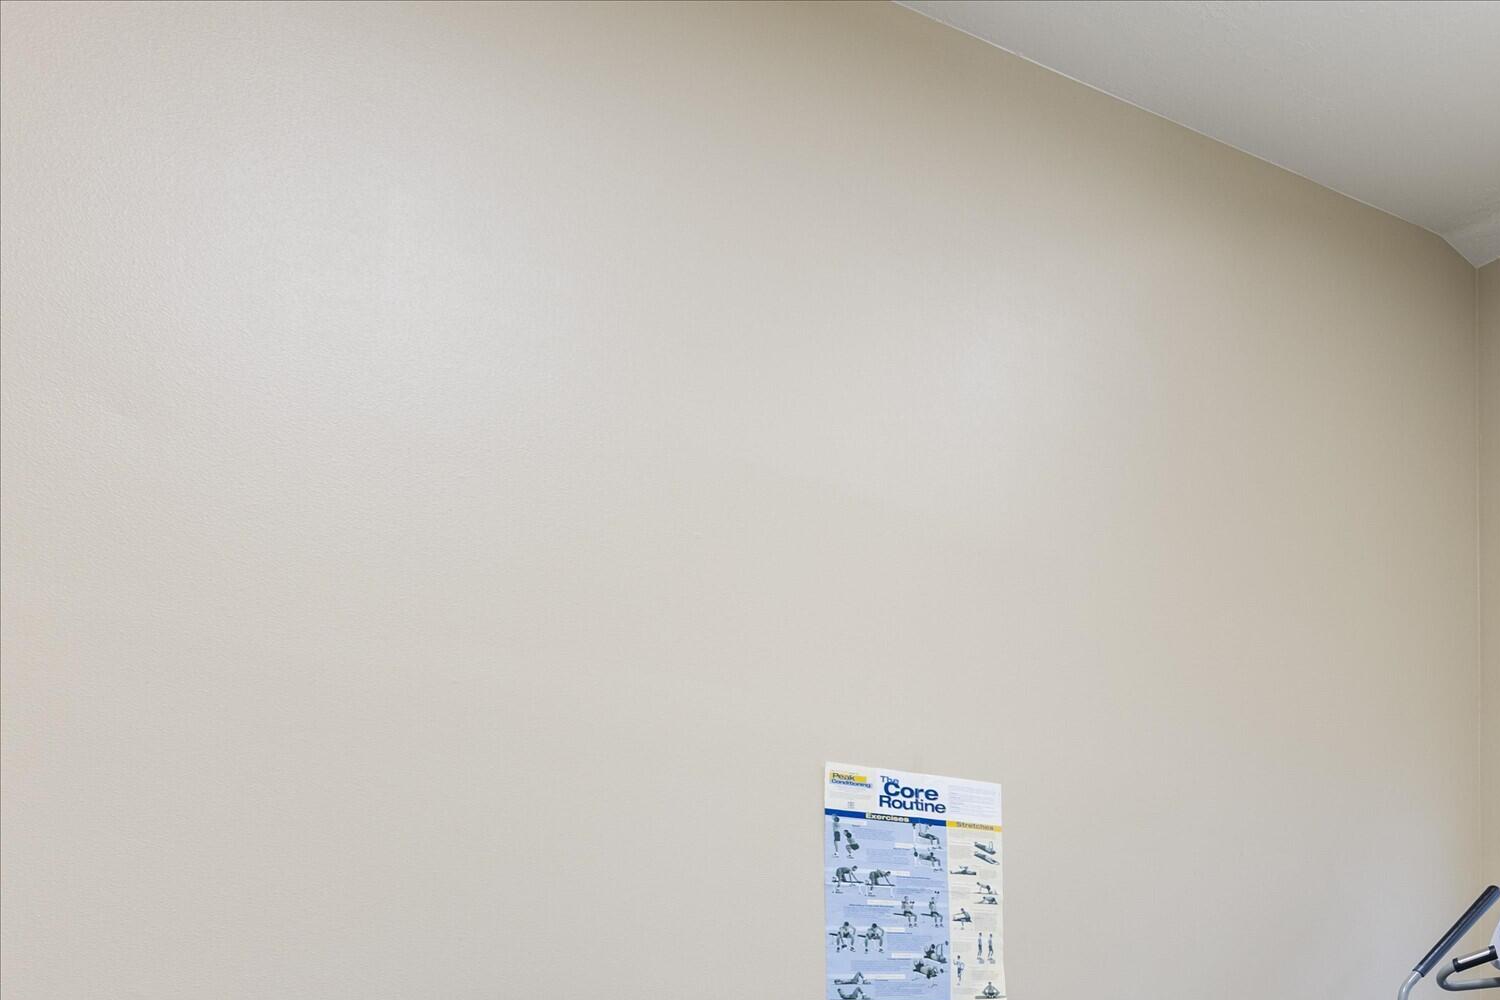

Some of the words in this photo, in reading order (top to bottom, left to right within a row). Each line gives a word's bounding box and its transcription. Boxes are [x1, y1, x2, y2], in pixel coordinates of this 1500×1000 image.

[833, 772, 856, 782] Peak
[880, 775, 899, 785] The
[831, 778, 872, 789] Conditioning
[884, 781, 939, 801] Core
[879, 795, 946, 814] Routine
[866, 811, 910, 823] Exercises
[956, 821, 994, 832] Stretches
